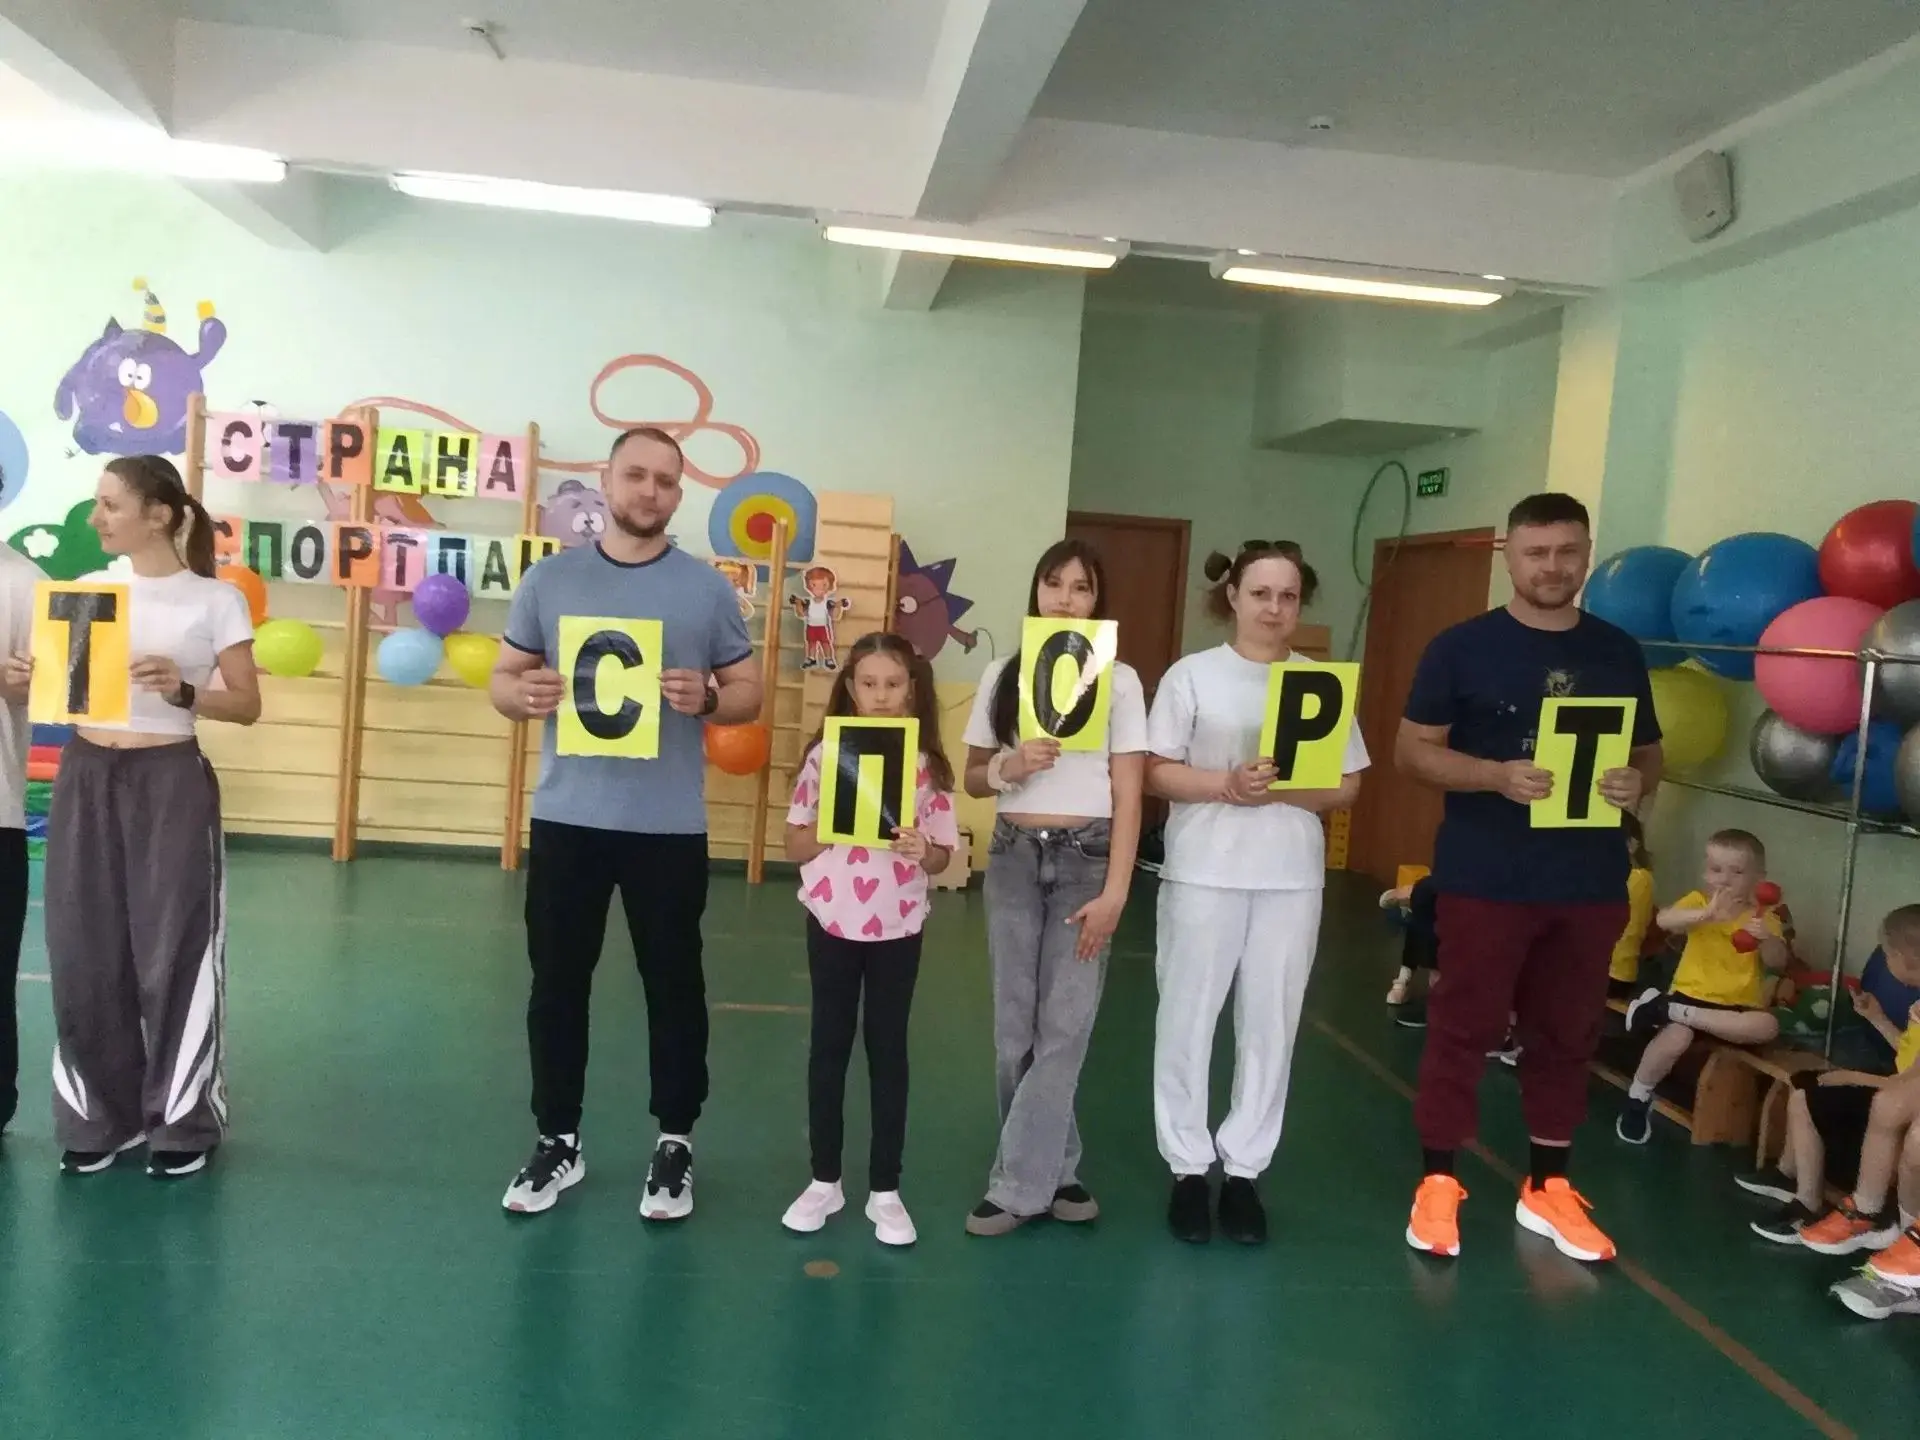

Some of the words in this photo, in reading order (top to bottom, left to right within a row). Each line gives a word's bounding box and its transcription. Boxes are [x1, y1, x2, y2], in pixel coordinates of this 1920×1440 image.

[221, 420, 516, 492] СТРАНА
[48, 591, 116, 714] Т
[573, 630, 643, 740] С
[1274, 670, 1343, 781] Р
[1554, 706, 1625, 819] Т
[833, 725, 905, 840] П
